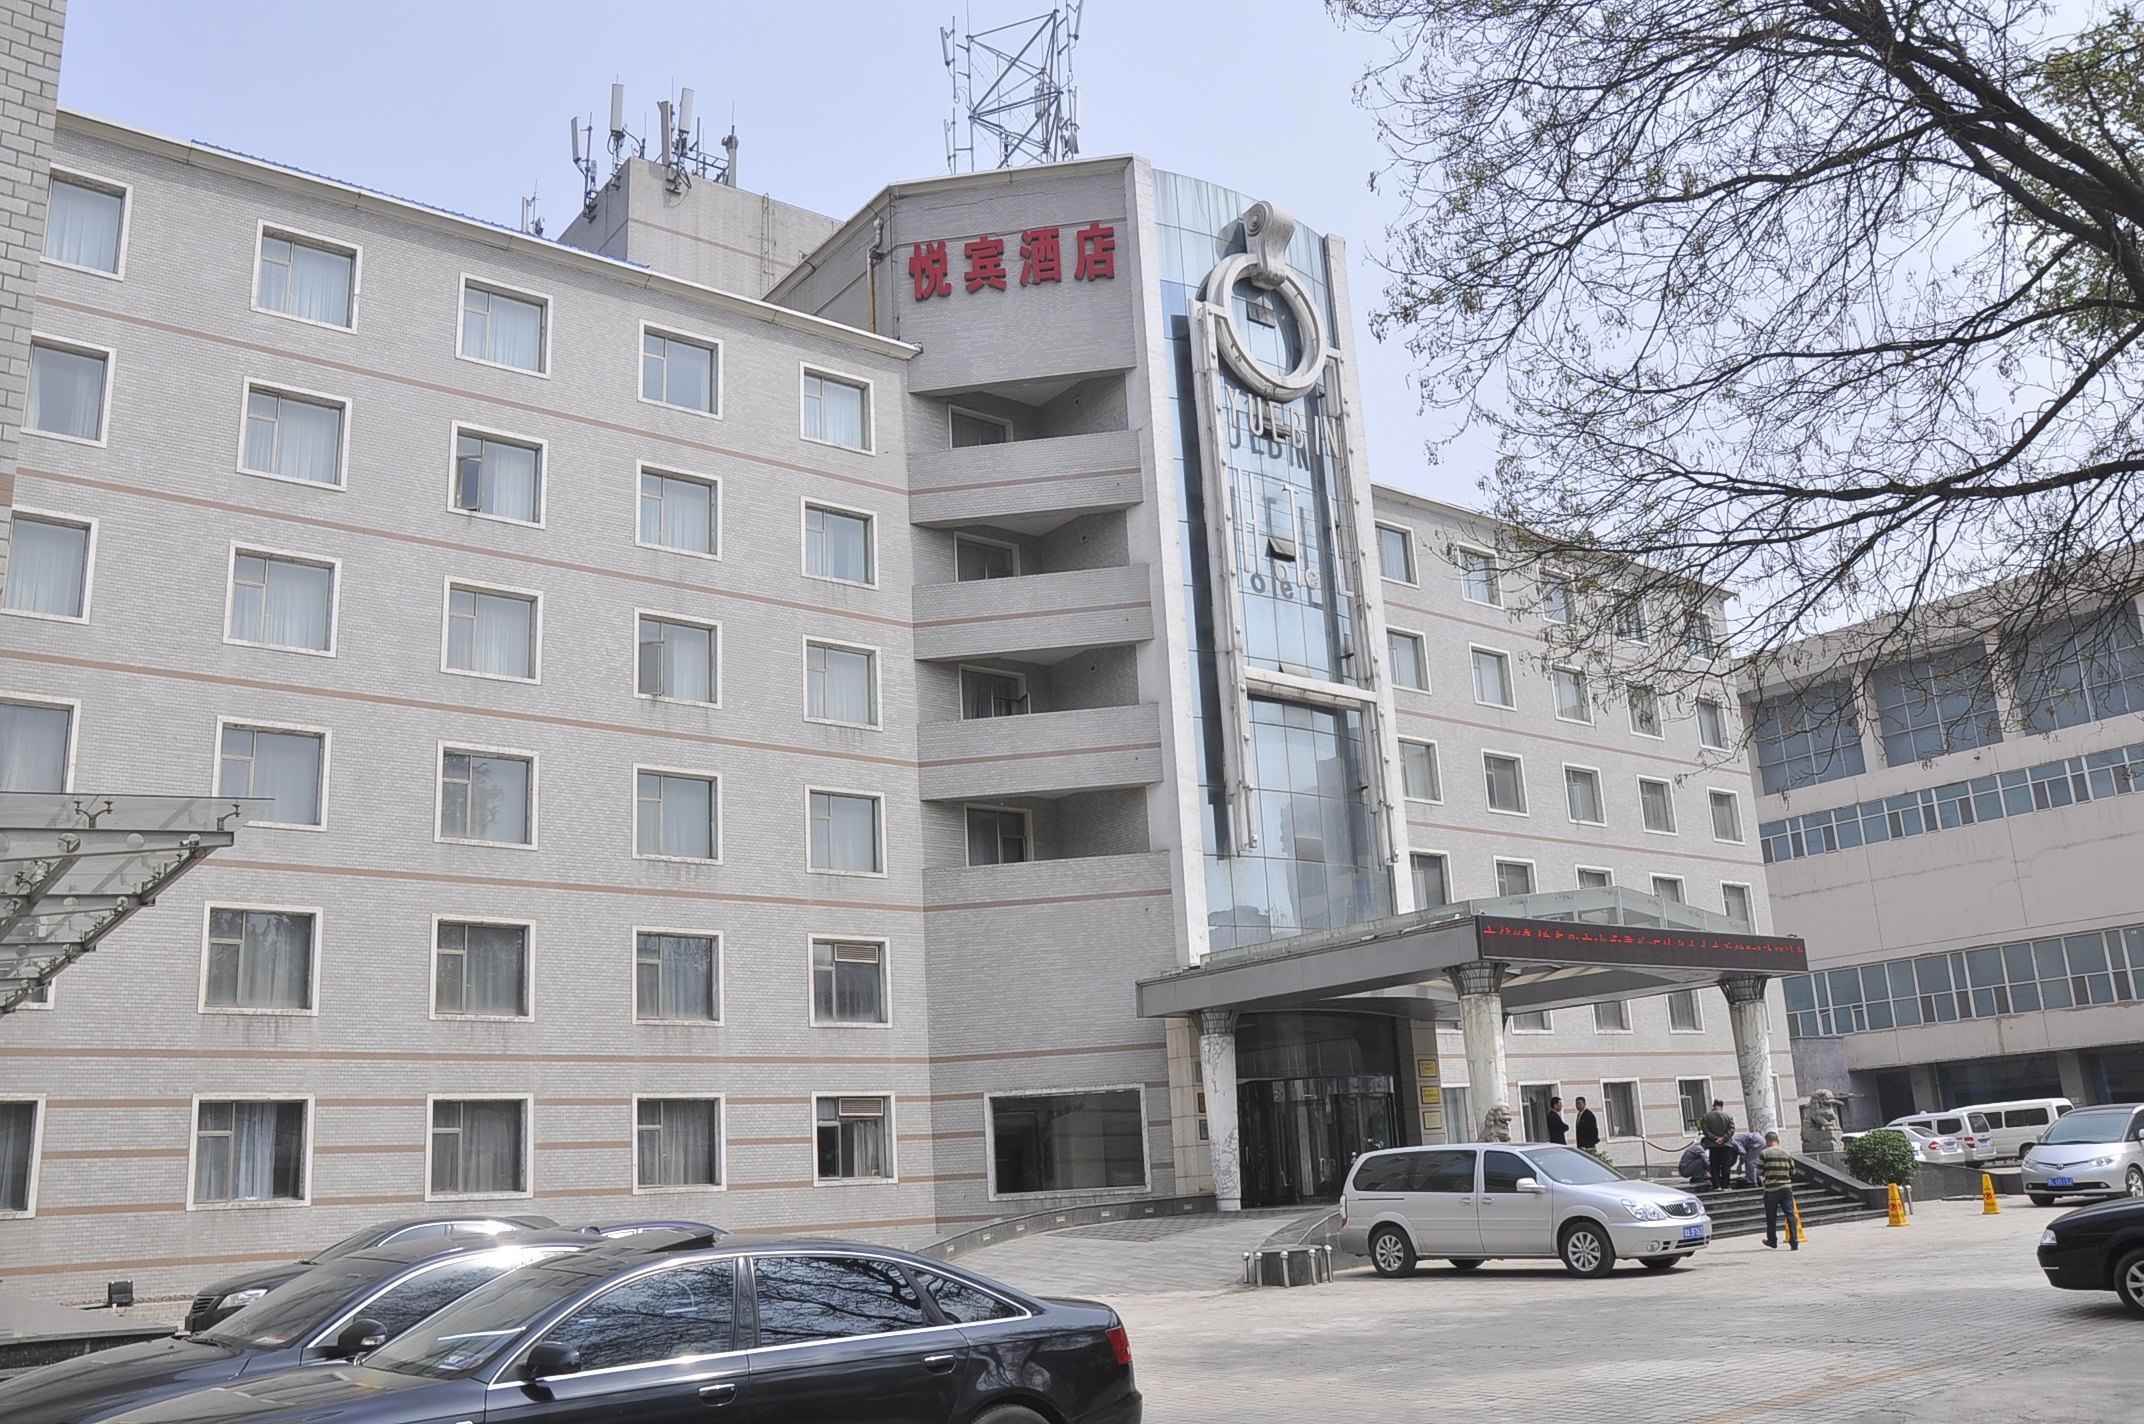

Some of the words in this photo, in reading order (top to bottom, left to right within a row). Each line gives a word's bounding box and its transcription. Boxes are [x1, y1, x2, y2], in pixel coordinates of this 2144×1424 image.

[909, 220, 1115, 301] 悦宾酒店
[1225, 383, 1340, 459] YUEBIN
